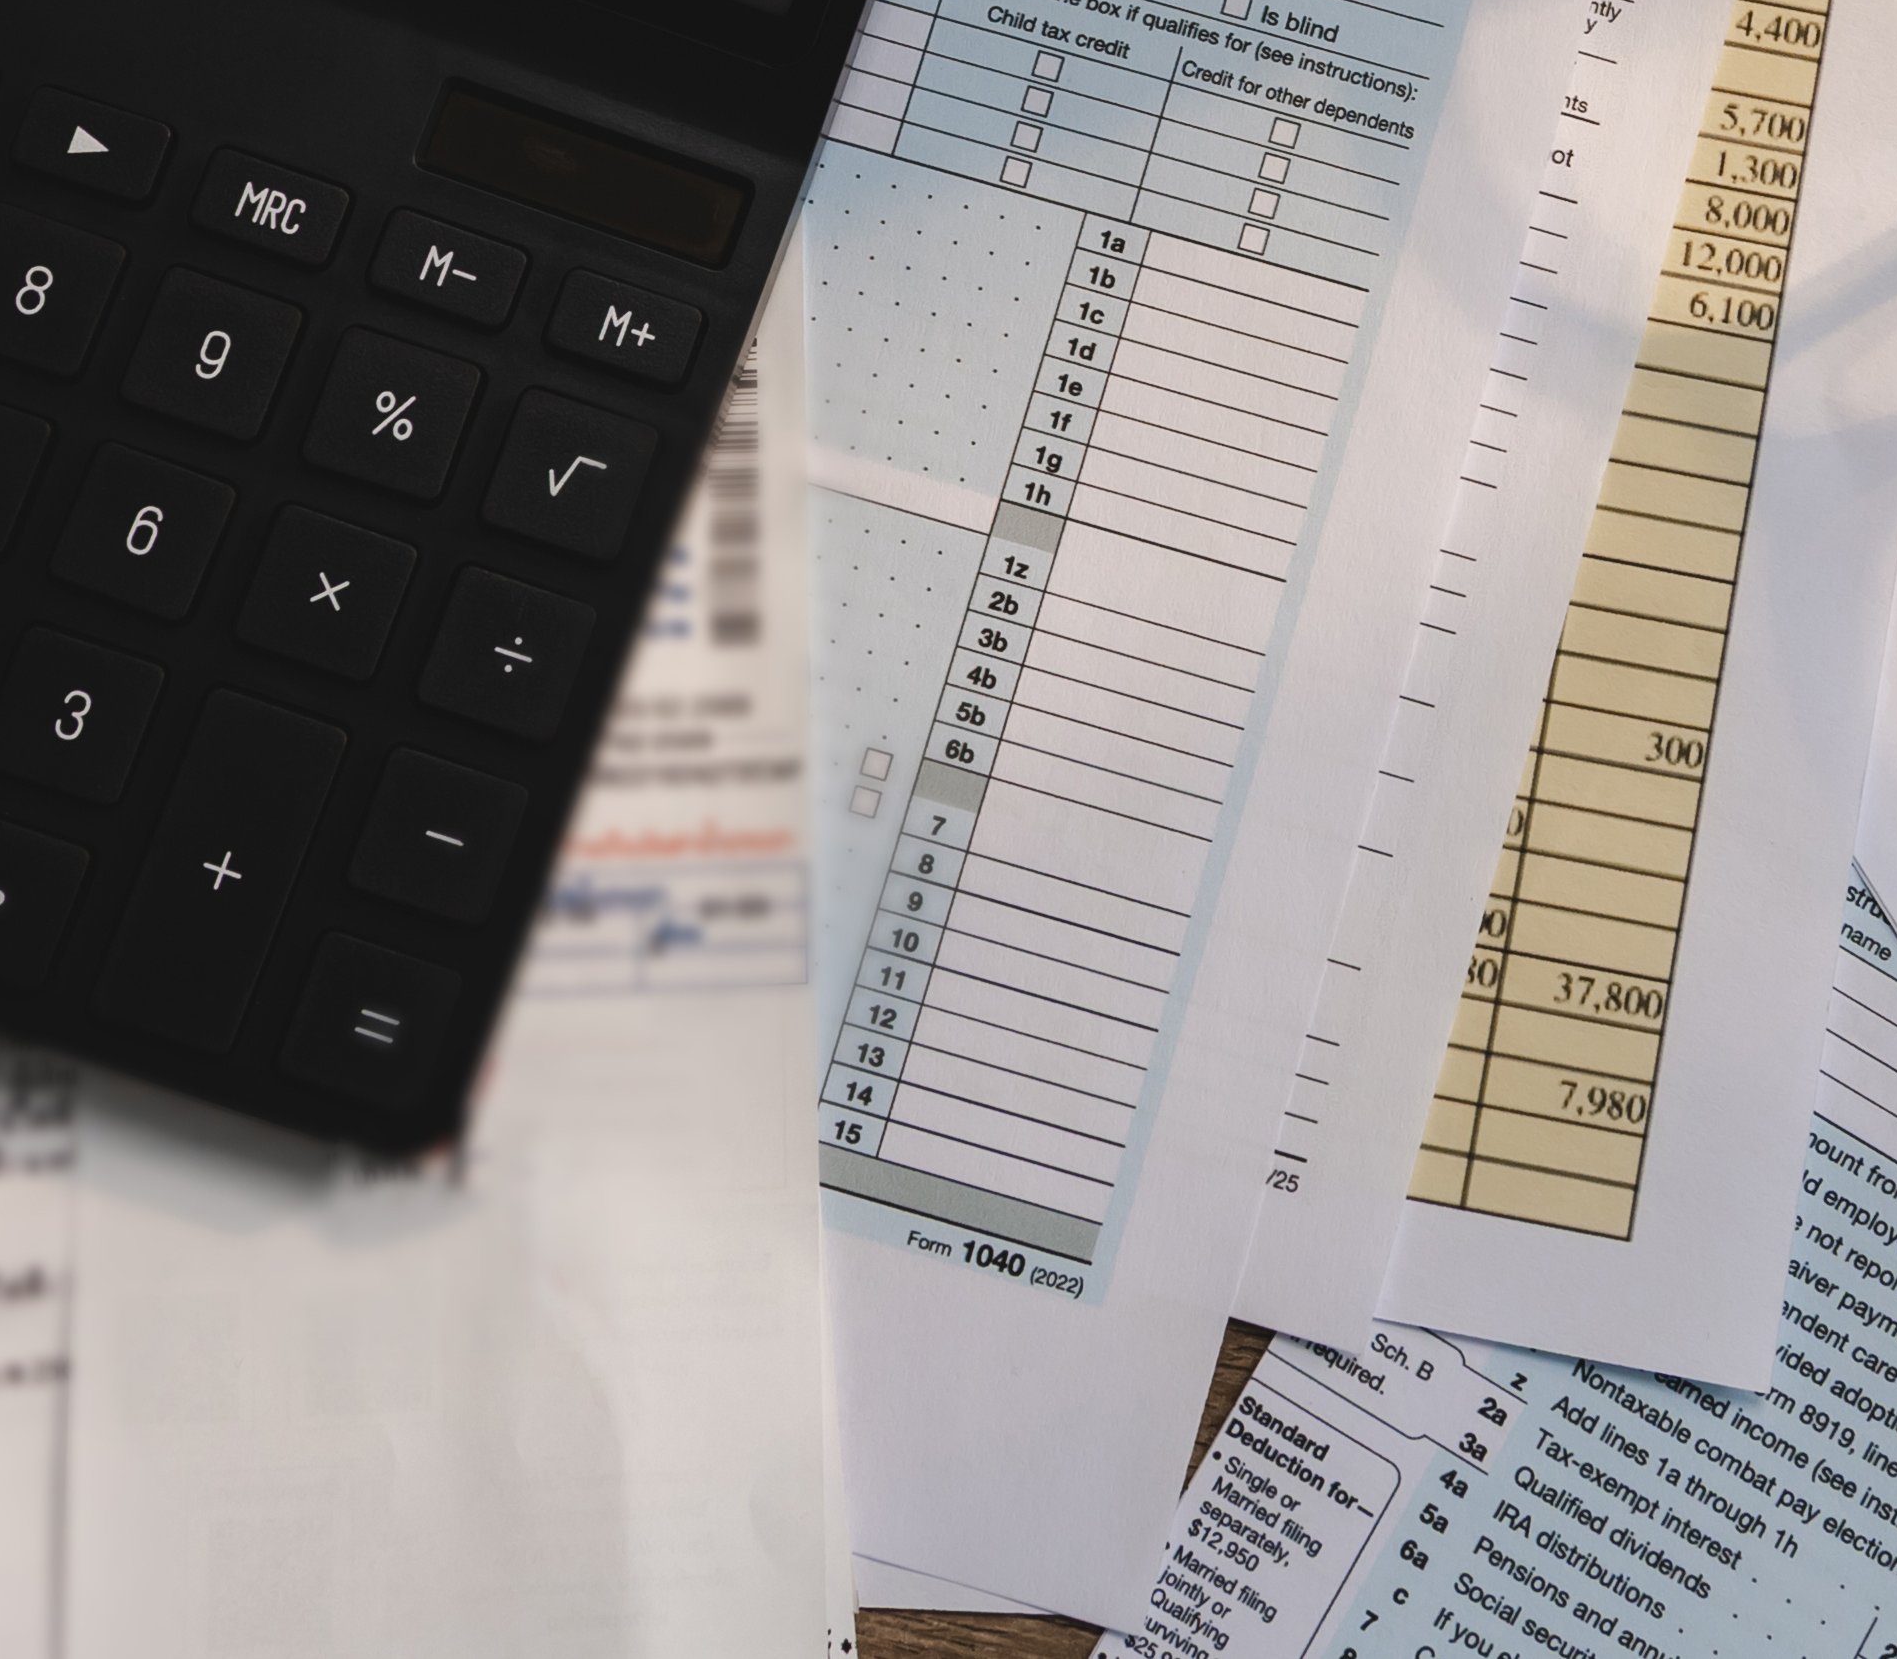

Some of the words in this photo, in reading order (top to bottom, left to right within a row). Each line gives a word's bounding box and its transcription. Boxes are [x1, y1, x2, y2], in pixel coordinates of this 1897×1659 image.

[1260, 5, 1280, 27] Is
[1284, 11, 1340, 44] blind
[1736, 10, 1822, 48] 4,400
[1720, 103, 1806, 142] 5,700
[234, 181, 307, 235] MRC
[1705, 197, 1790, 235] 8,000
[1099, 231, 1127, 254] 1a
[1682, 241, 1782, 283] 12,000
[15, 265, 53, 315] 8
[598, 305, 656, 347] M+
[1690, 294, 1775, 331] 6,100
[195, 330, 231, 379] 9
[1067, 338, 1097, 362] 1d
[372, 391, 416, 441] %
[126, 505, 163, 555] 6
[988, 591, 1020, 616] 2b
[55, 690, 92, 740] 3
[954, 702, 987, 727] 5b
[1645, 732, 1704, 768] 300
[917, 854, 935, 875] 8
[868, 1005, 898, 1030] 12
[1553, 972, 1664, 1020] 37,800
[1560, 1080, 1647, 1124] 7,980
[833, 1121, 863, 1145] 15
[906, 1230, 952, 1257] Form
[962, 1239, 1026, 1277] 1040
[1029, 1266, 1084, 1299] (2022)
[1239, 1396, 1330, 1462] Standard
[1225, 1419, 1325, 1492] Deduction
[1536, 1427, 1660, 1520] Tax-exempt
[1660, 1507, 1742, 1571] interest
[1187, 1518, 1260, 1572] $12,950
[1514, 1465, 1609, 1535] Qualified
[1609, 1527, 1711, 1599] dividends
[1492, 1499, 1532, 1539] IRA
[1535, 1530, 1666, 1619] distributions
